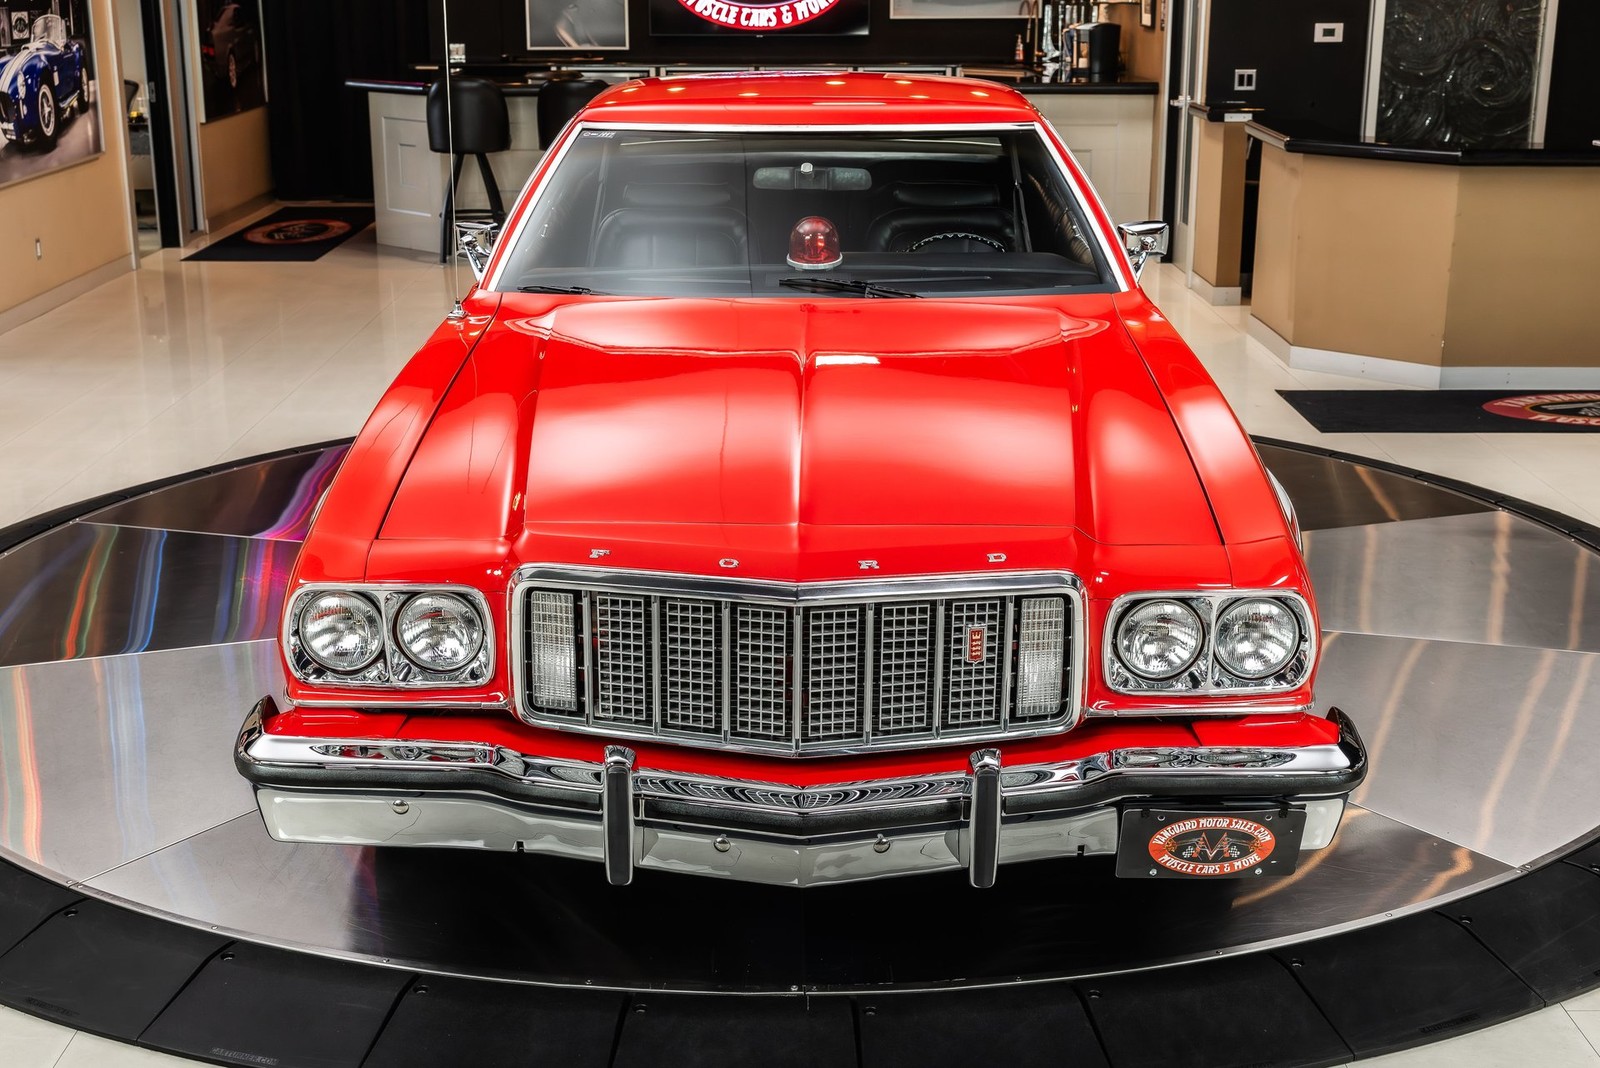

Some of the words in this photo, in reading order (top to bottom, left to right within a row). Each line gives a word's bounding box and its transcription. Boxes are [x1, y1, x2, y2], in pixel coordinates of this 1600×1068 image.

[740, 7, 777, 27] CARS
[781, 5, 793, 25] &
[1152, 818, 1198, 846] VANGUARD
[1199, 817, 1228, 829] MOTOR
[1229, 818, 1273, 843] SALES.COM
[1158, 853, 1194, 873] MUSCLE
[1195, 864, 1220, 875] CARS
[1223, 863, 1231, 873] &
[1234, 853, 1262, 870] MORE
